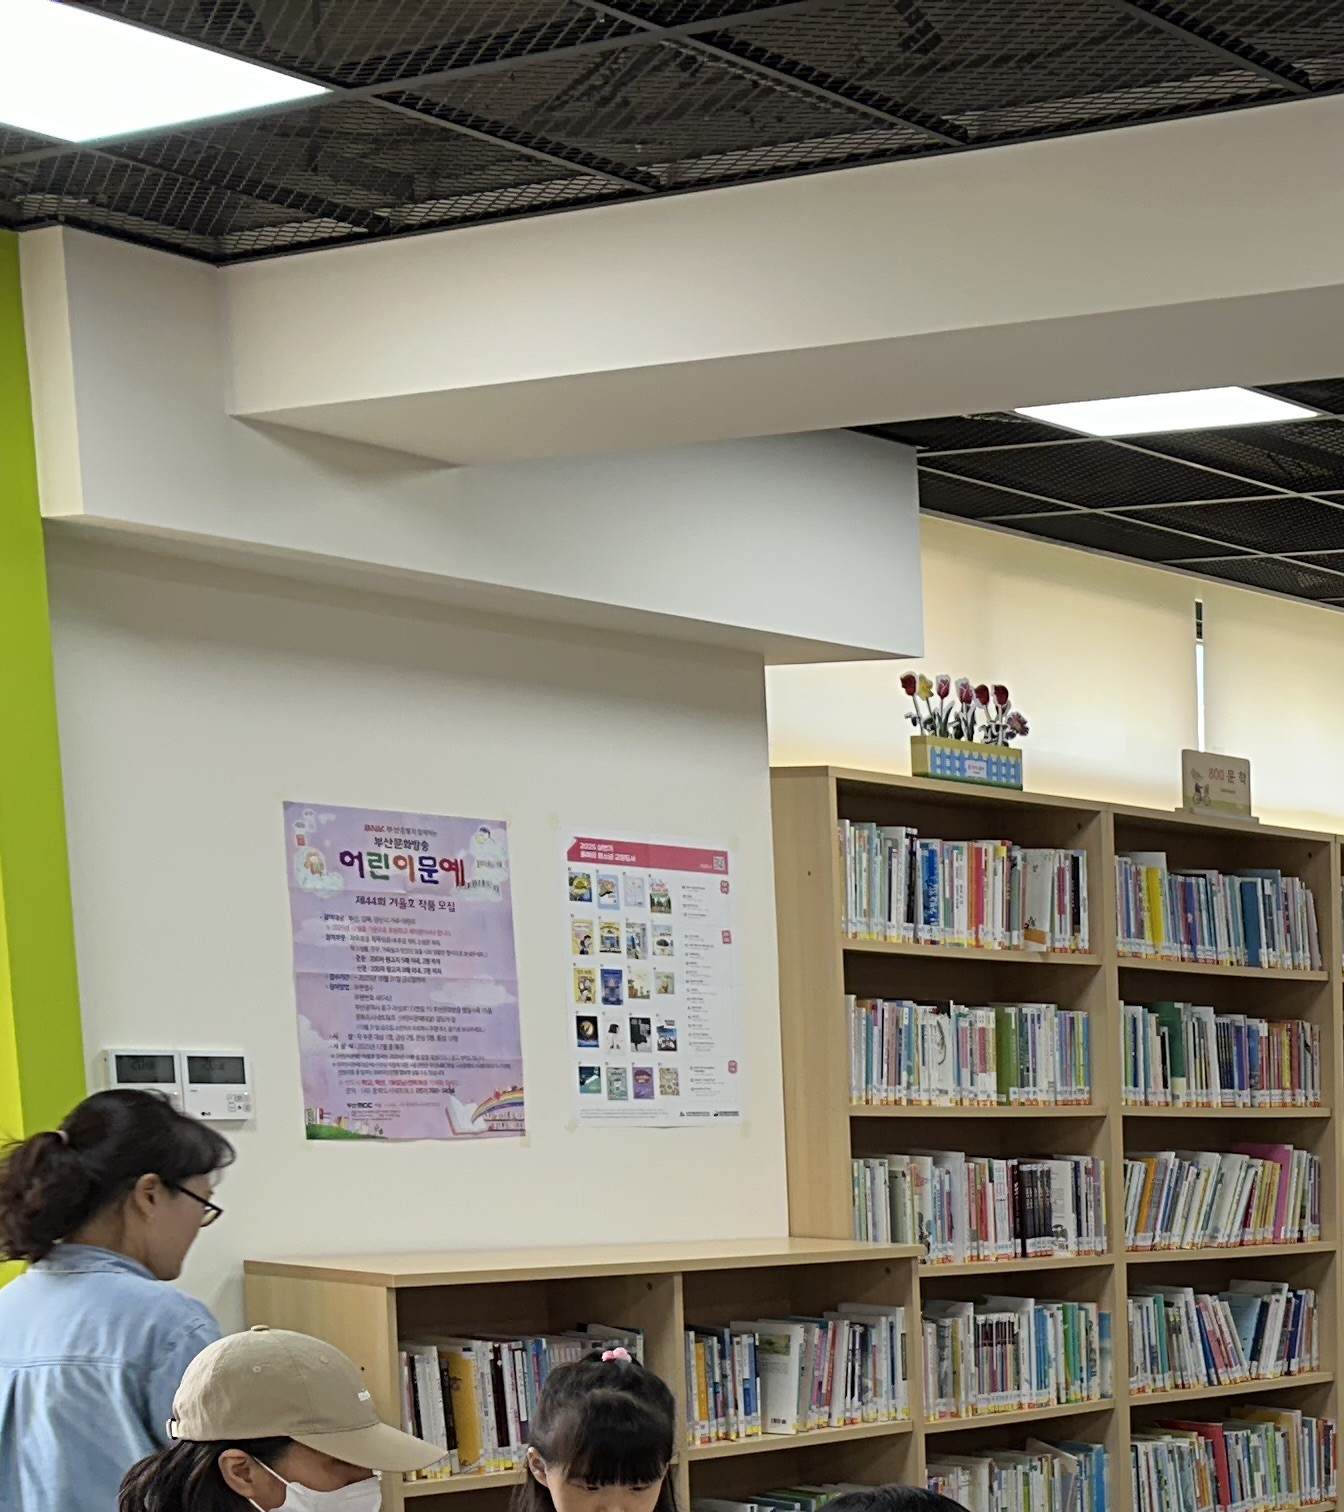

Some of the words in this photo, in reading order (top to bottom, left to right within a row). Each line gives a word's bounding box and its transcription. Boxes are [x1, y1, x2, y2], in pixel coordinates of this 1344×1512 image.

[339, 850, 466, 888] 어린이문예
[418, 899, 436, 911] 작품
[438, 901, 456, 912] 모집
